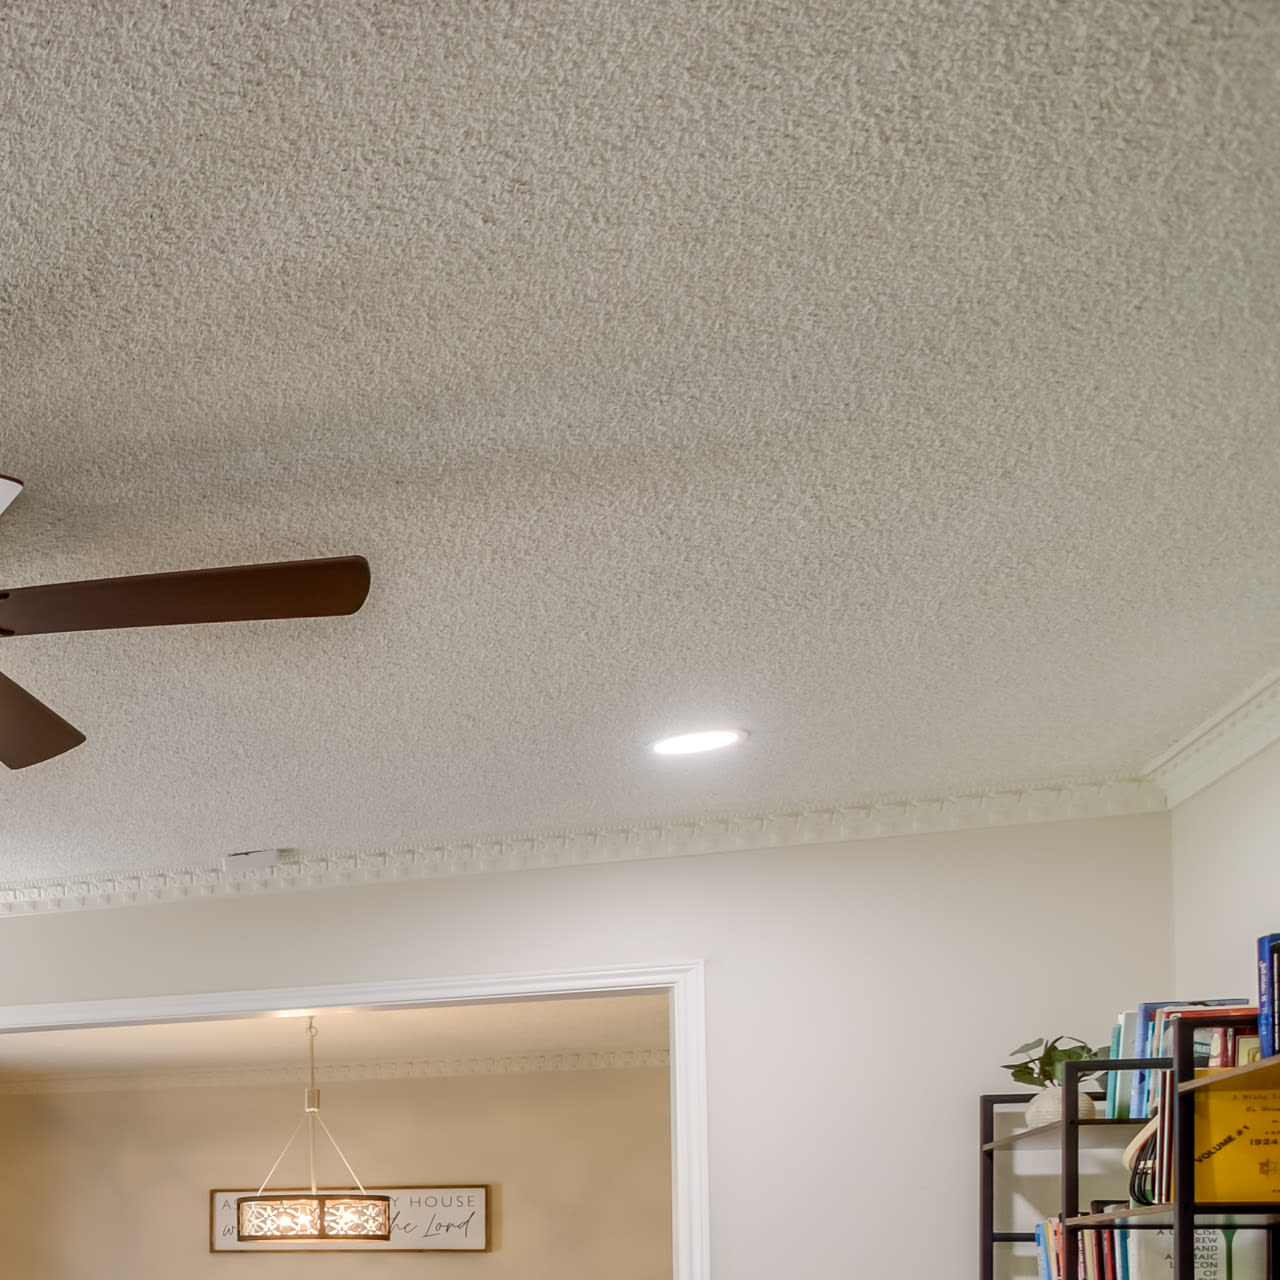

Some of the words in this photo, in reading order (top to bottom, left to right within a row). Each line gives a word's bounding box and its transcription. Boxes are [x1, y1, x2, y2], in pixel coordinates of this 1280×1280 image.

[1194, 1134, 1236, 1164] VOLUME
[409, 1195, 476, 1208] HOUSE
[389, 1210, 418, 1236] he
[422, 1210, 476, 1238] Lord
